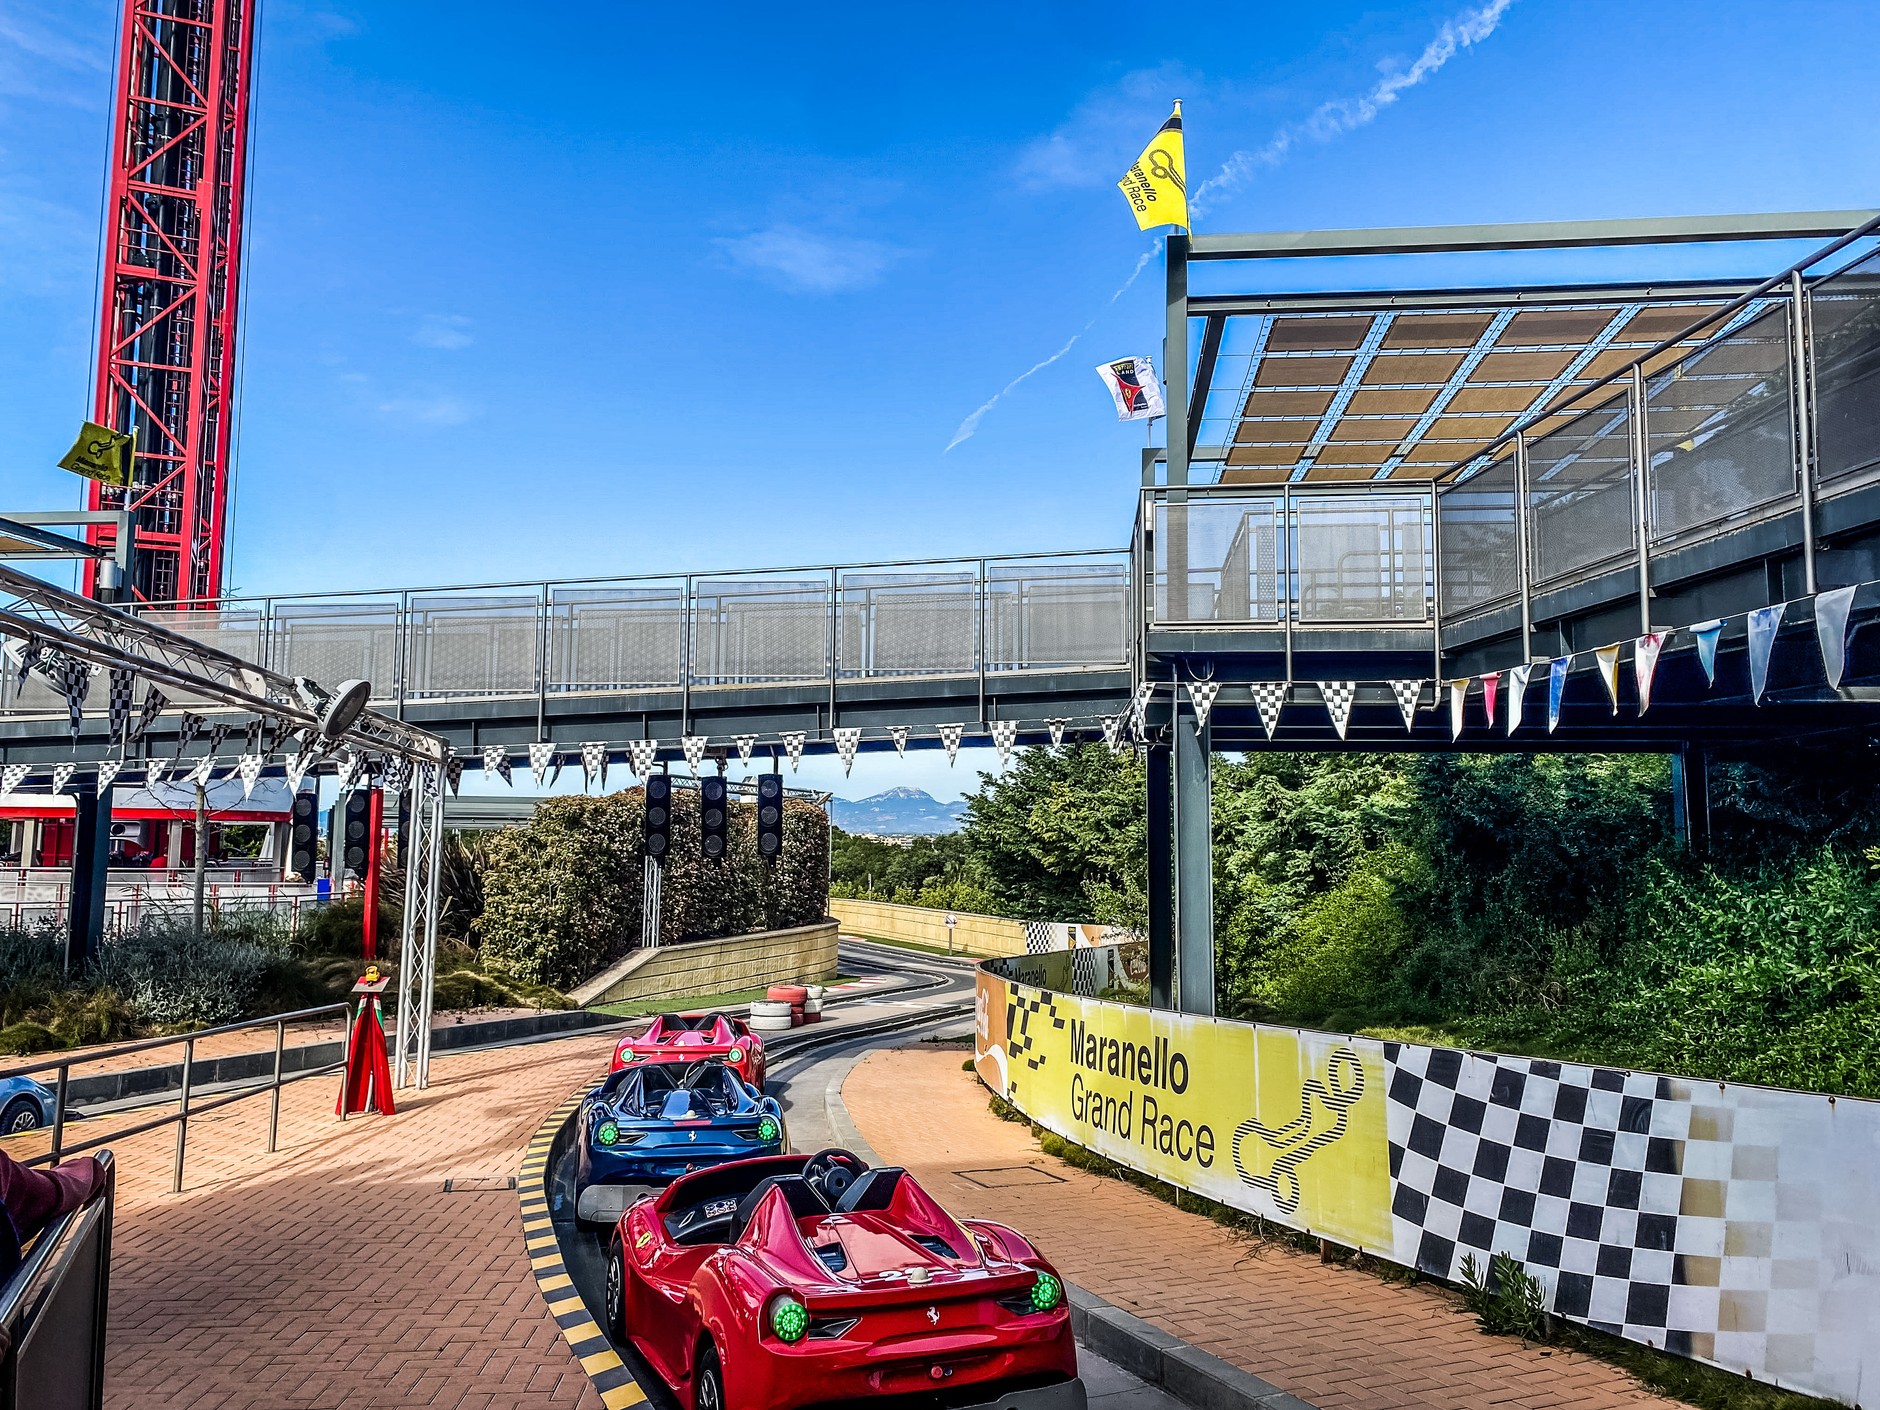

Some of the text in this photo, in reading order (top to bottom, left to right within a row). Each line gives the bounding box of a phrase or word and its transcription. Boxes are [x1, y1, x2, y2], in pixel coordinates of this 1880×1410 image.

[1127, 185, 1147, 212] Race
[1070, 1018, 1189, 1095] Maranello
[1071, 1073, 1216, 1169] Grand Race
